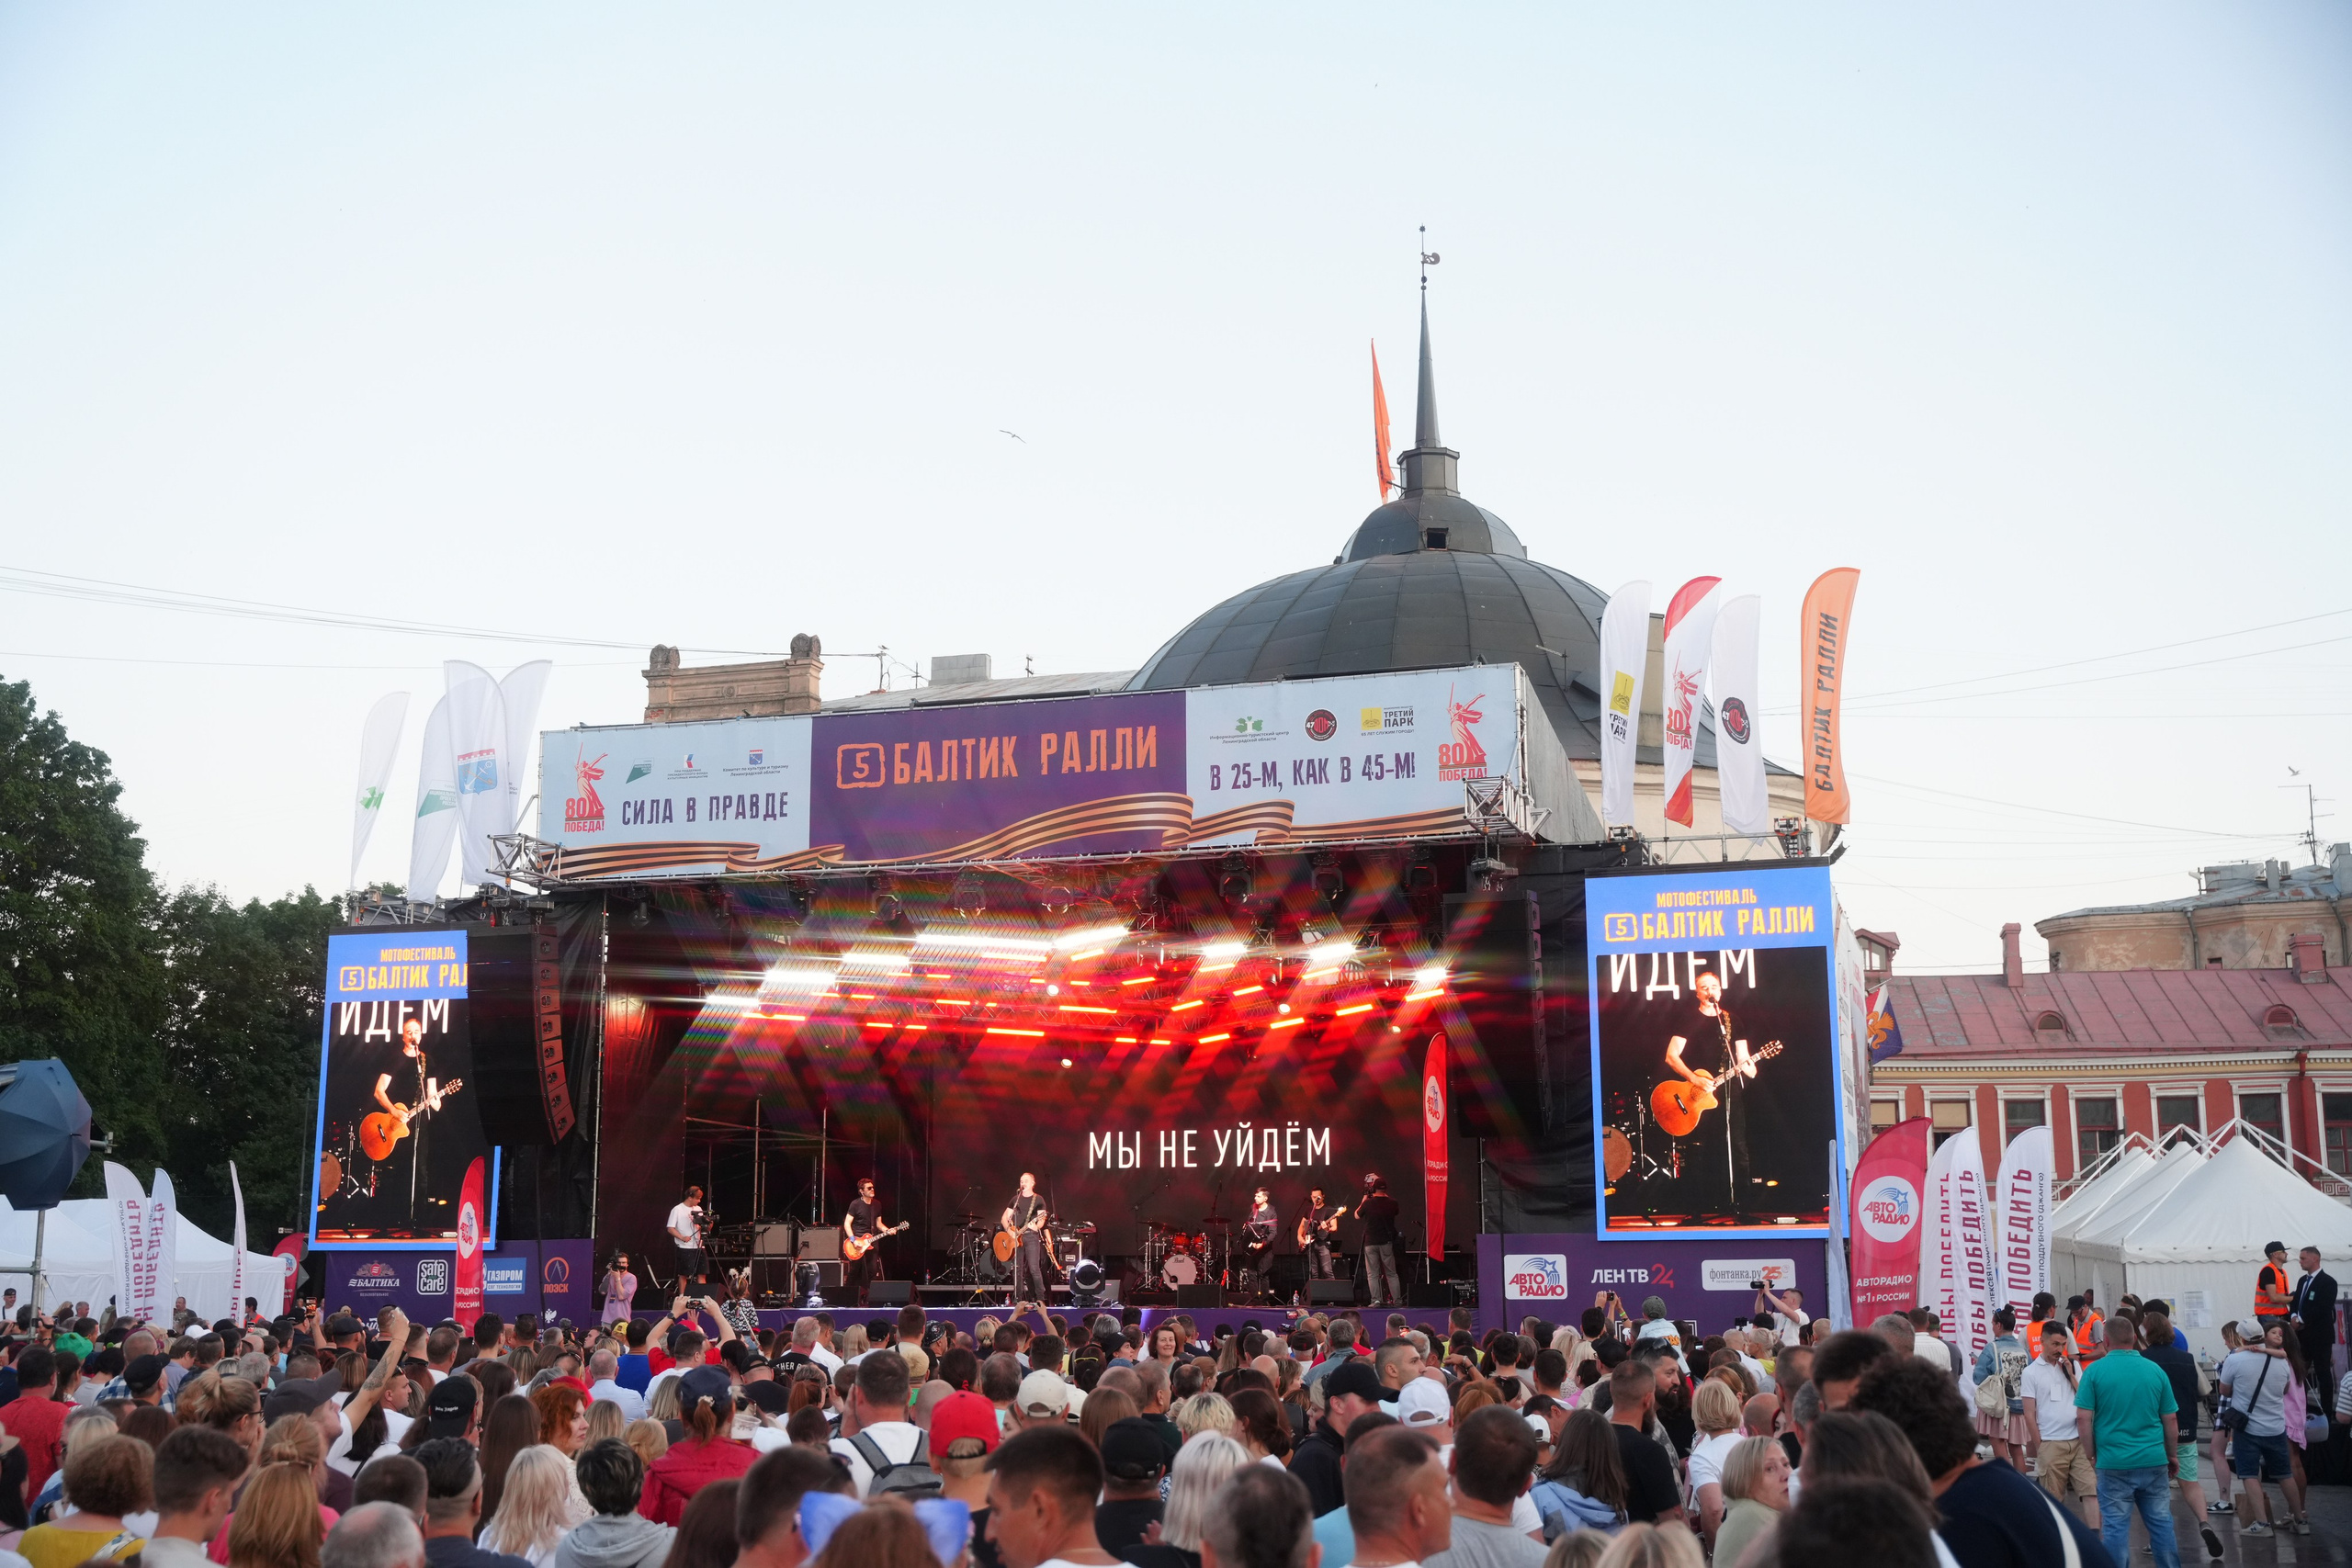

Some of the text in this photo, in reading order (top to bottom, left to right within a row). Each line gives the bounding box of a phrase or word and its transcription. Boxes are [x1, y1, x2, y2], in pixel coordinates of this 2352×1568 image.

[1815, 612, 1838, 792] БАЛТИК РАЛЛИ
[1384, 708, 1414, 718] ТРЕТИЙ
[1384, 717, 1414, 728] ПАРК
[853, 726, 1157, 784] 5 БАЛТИК РАЛЛИ
[1439, 743, 1464, 766] 80
[1210, 751, 1416, 793] В 25-М, КАК В 45-М!
[1439, 766, 1487, 782] ПОБЕДА!
[565, 797, 588, 818] 80
[622, 792, 788, 826] СИЛА В ПРАВДЕ
[564, 820, 605, 833] ПОБЕДА!
[1657, 888, 1758, 908] МОТОФЕСТИВАЛЬ
[1615, 906, 1815, 940] 5 БАЛТИК РАЛЛИ
[380, 946, 456, 963] МОТОФЕСТИВАЛЬ
[347, 970, 357, 987] 5
[368, 965, 429, 990] БАЛТИК
[1089, 1122, 1331, 1173] МЫ НЕ УЙДЁМ
[2038, 1172, 2046, 1213] (ДЖАНГО)
[1863, 1201, 1896, 1213] АВТО
[1871, 1213, 1910, 1225] РАДИО
[1959, 1169, 1985, 1290] ПОБЕДИТЬ
[2007, 1168, 2034, 1292] ПОБЕДИТЬ
[2037, 1215, 2046, 1271] ПОДДУБНОГО
[421, 1259, 445, 1277] safe
[487, 1269, 523, 1281] ГАЗПРОМ
[1710, 1266, 1782, 1281] фонтанка.ру 25
[357, 1278, 400, 1287] БАЛТИКА
[420, 1277, 445, 1292] care
[1509, 1273, 1544, 1285] АВТО
[1856, 1274, 1912, 1287] АВТОРАДИО
[544, 1283, 569, 1293] ЛОЭСК
[1520, 1284, 1565, 1297] РАДИО
[1857, 1292, 1871, 1303] №1
[1876, 1292, 1910, 1302] РОССИИ
